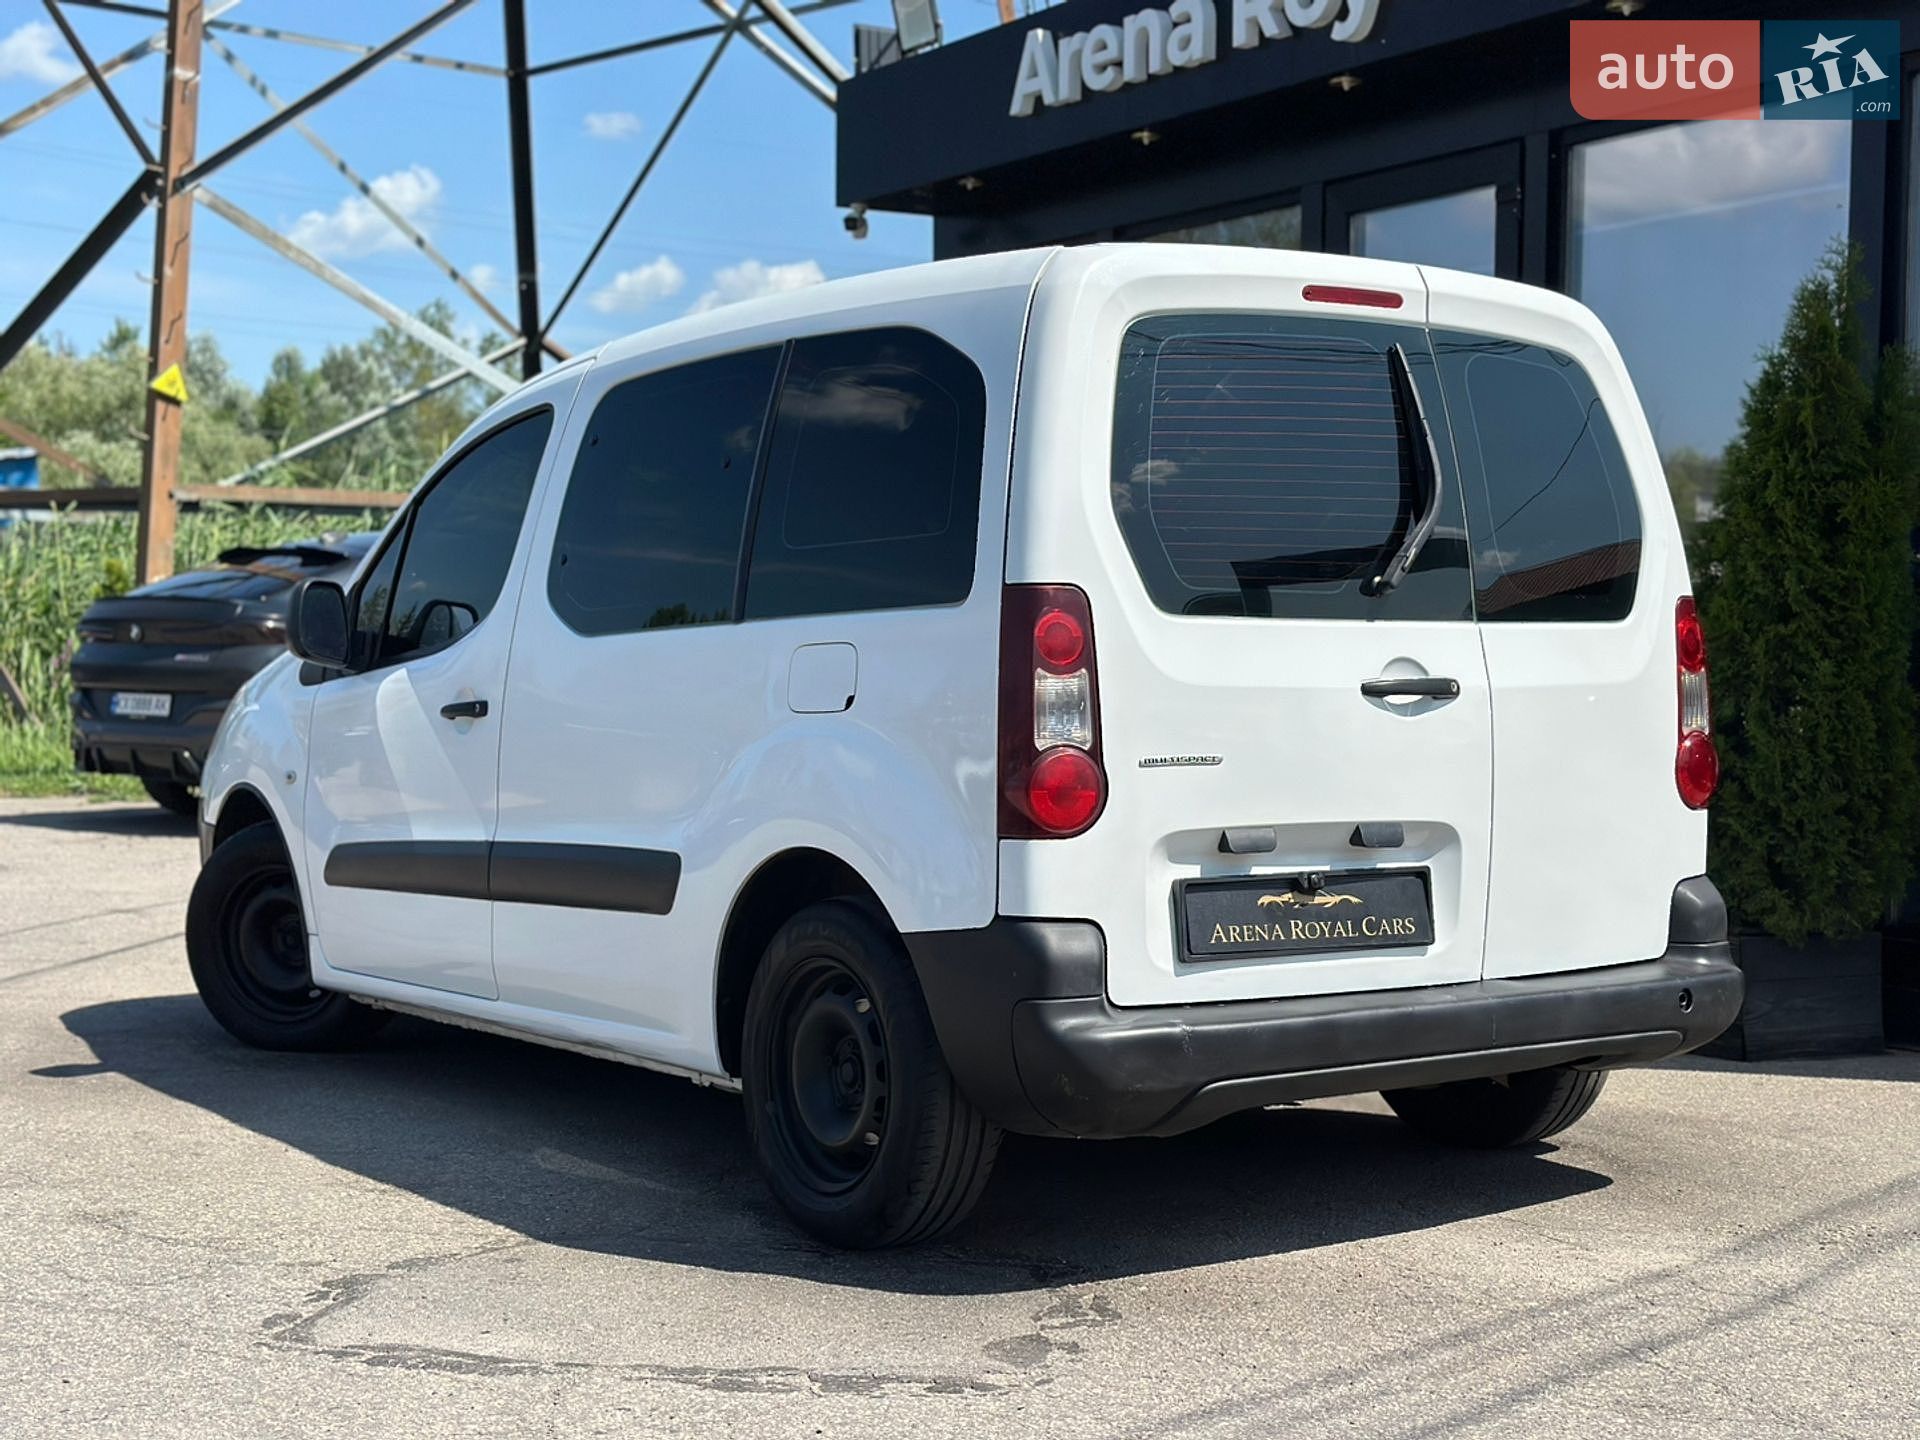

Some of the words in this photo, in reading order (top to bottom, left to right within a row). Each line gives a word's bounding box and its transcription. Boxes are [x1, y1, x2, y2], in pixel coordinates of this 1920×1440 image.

[1009, 0, 1217, 116] Arena
[1210, 923, 1286, 944] ARENA
[1290, 918, 1359, 940] ROYAL
[1362, 915, 1416, 936] CARS
